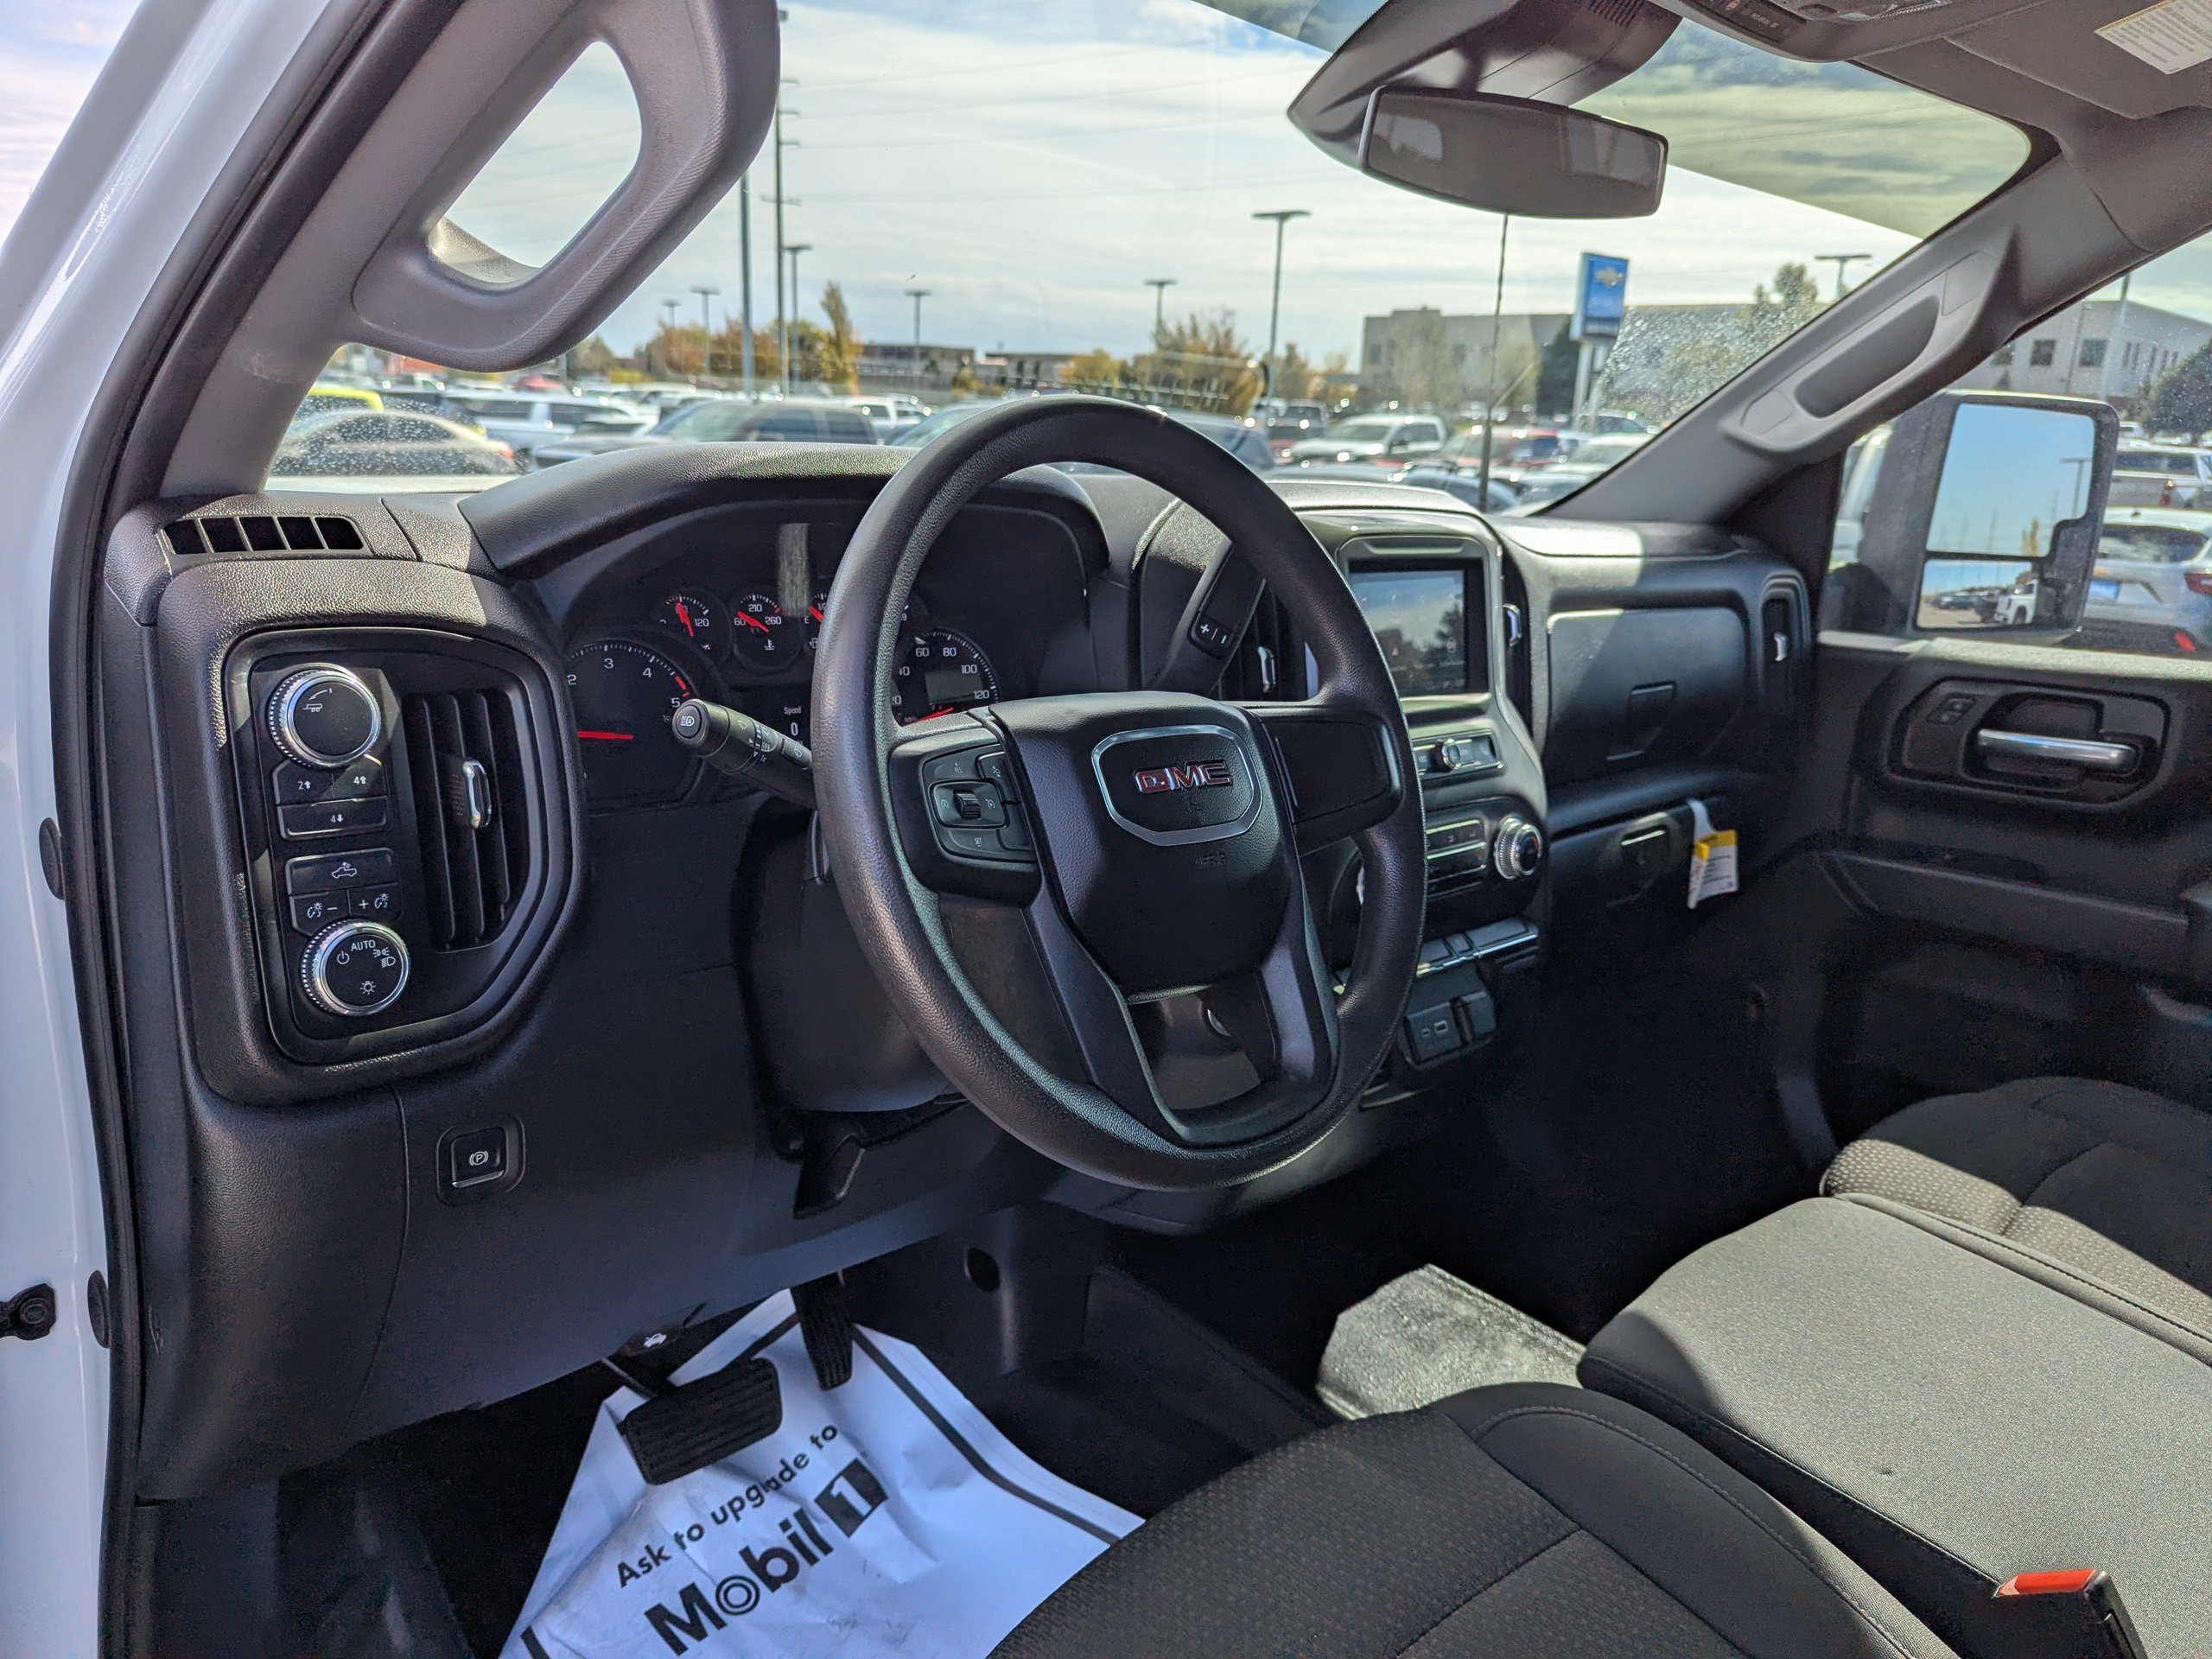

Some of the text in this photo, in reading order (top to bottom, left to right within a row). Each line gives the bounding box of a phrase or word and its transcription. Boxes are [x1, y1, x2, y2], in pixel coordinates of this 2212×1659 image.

[748, 604, 762, 613] 210
[695, 618, 709, 627] 120
[764, 616, 782, 626] 260
[915, 647, 930, 658] 60
[943, 646, 957, 657] 80
[604, 658, 614, 670] 3
[961, 664, 978, 674] 100
[642, 668, 652, 678] 4
[567, 674, 577, 685] 2
[974, 690, 990, 700] 120
[671, 697, 681, 708] 5
[784, 706, 802, 716] Speed
[791, 722, 798, 736] 0
[1135, 762, 1230, 794] GMC
[351, 939, 376, 951] AUTO
[617, 1544, 672, 1588] Ask
[673, 1523, 705, 1550] to
[810, 1425, 837, 1450] to
[644, 1507, 834, 1656] Mobil
